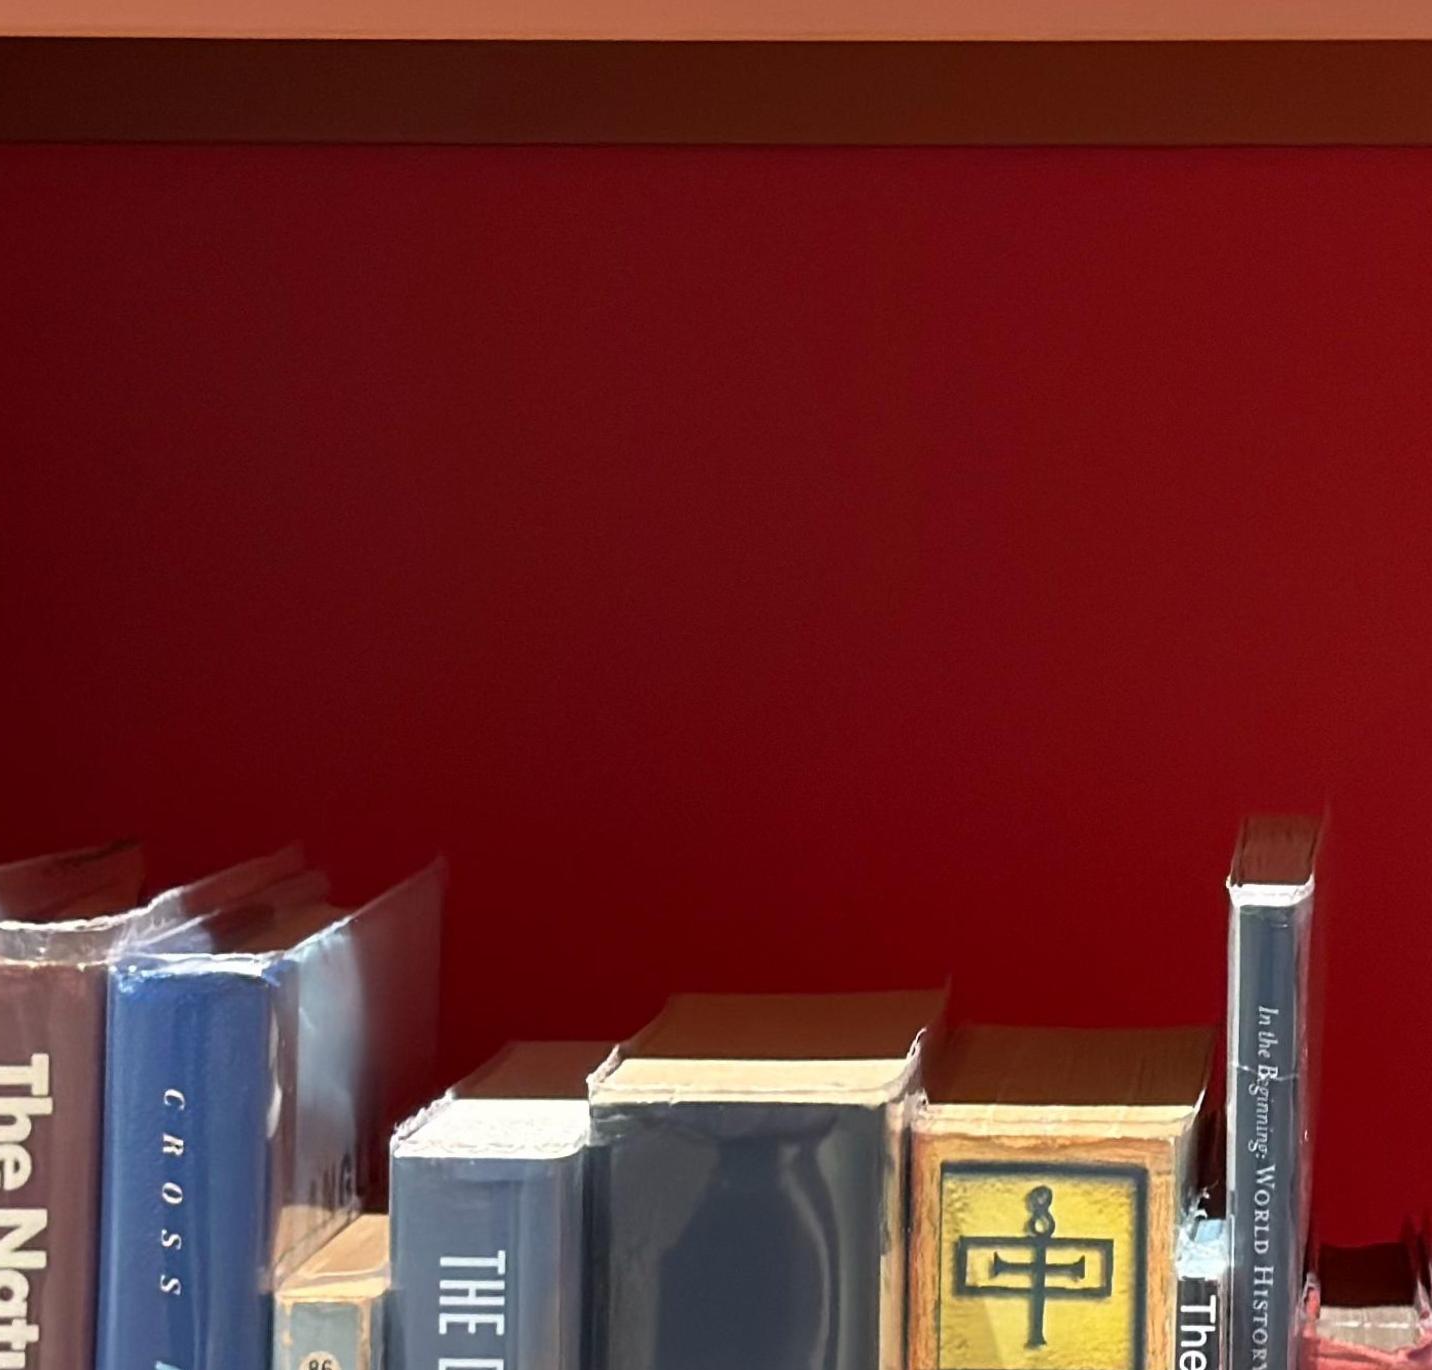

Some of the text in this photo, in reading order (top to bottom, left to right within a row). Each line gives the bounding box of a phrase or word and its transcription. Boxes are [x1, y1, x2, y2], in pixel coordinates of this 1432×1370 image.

[1257, 1032, 1278, 1058] the
[1258, 1006, 1279, 1025] In
[159, 1088, 186, 1295] CROSS
[1253, 1165, 1275, 1253] WORLD
[437, 1250, 506, 1336] THE
